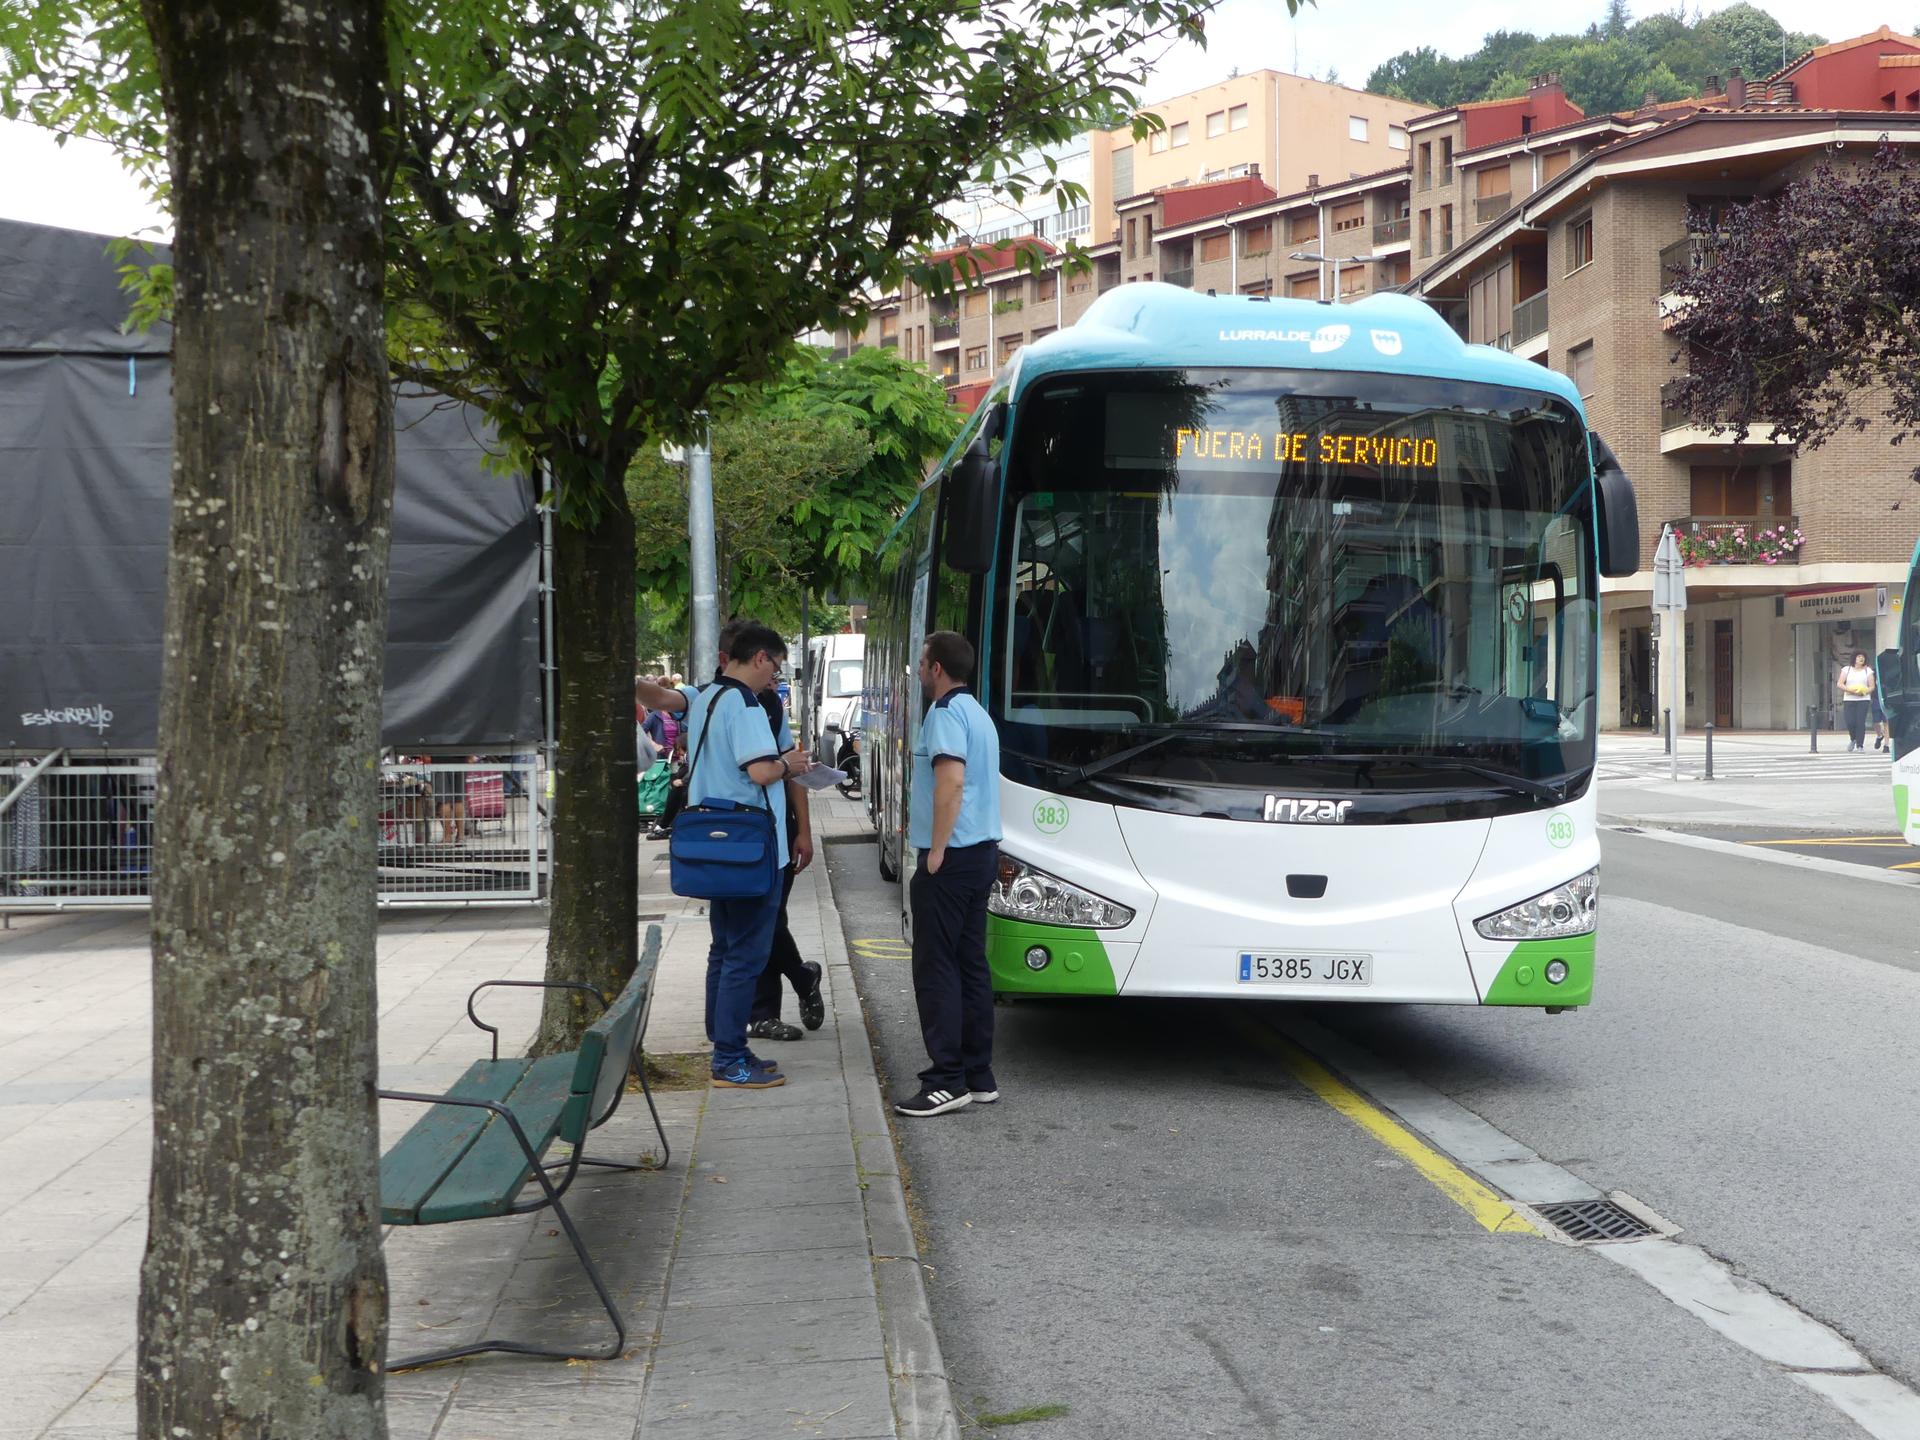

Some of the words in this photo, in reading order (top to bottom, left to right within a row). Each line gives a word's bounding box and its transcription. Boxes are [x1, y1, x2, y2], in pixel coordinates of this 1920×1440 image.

[1176, 428, 1262, 460] FUERA
[1274, 433, 1308, 462] DE
[1319, 435, 1437, 467] SERVICIO
[1830, 594, 1860, 606] FASHION
[1037, 806, 1066, 826] 383
[1264, 794, 1353, 824] Irizar
[1550, 822, 1572, 840] 383
[1256, 957, 1312, 980] 5385
[1323, 959, 1364, 981] JGX
